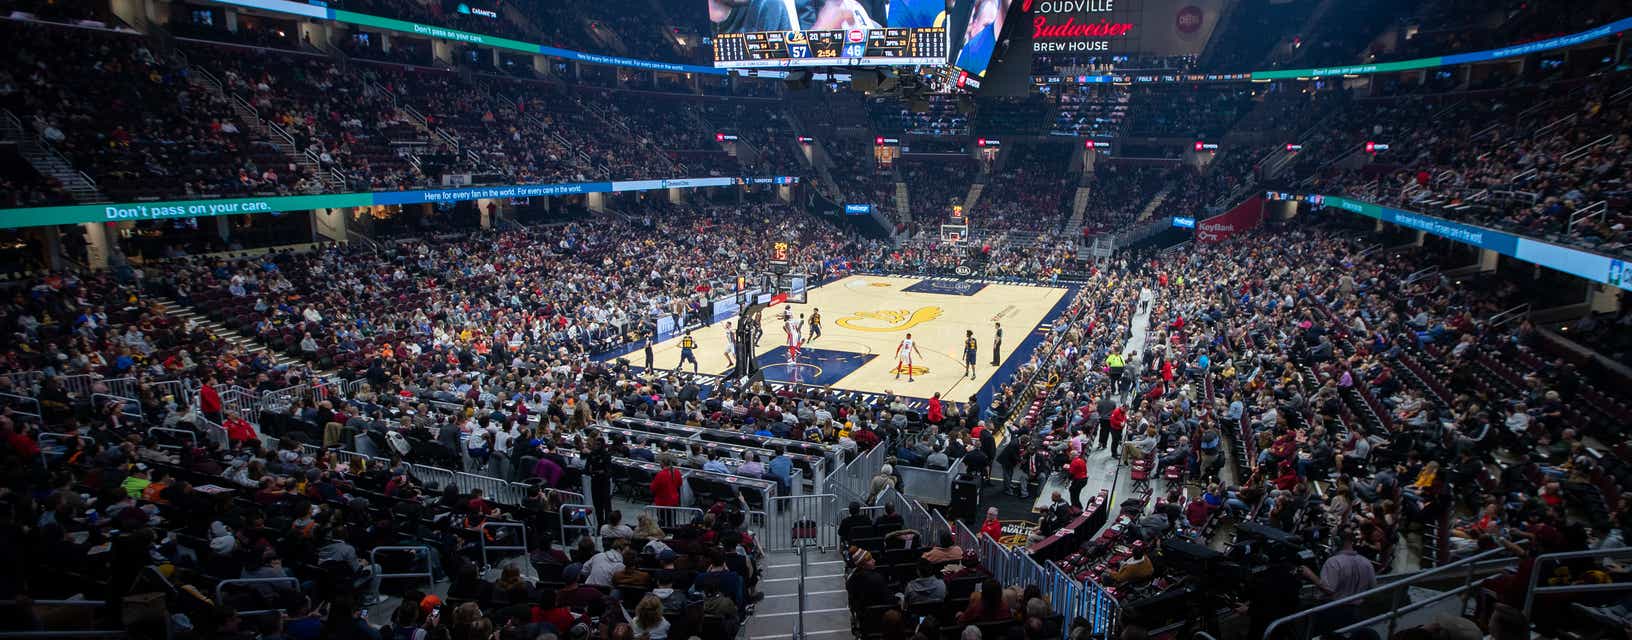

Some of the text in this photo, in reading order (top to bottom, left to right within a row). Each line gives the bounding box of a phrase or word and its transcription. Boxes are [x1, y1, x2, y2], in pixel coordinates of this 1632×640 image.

[1034, 0, 1113, 13] OUDVILLE
[414, 24, 431, 34] Don't
[1034, 41, 1109, 51] BREW HOUSE
[793, 46, 806, 58] 57
[817, 49, 836, 57] 2:54
[847, 46, 861, 57] 46
[425, 192, 441, 200] Here
[442, 191, 451, 199] for
[453, 192, 470, 200] every
[471, 189, 481, 198] fan
[489, 189, 498, 197] the
[518, 187, 526, 195] For
[528, 187, 542, 196] every
[106, 202, 271, 219] Don't pass on your care.
[1200, 223, 1233, 233] KeyBank
[776, 250, 786, 260] 15
